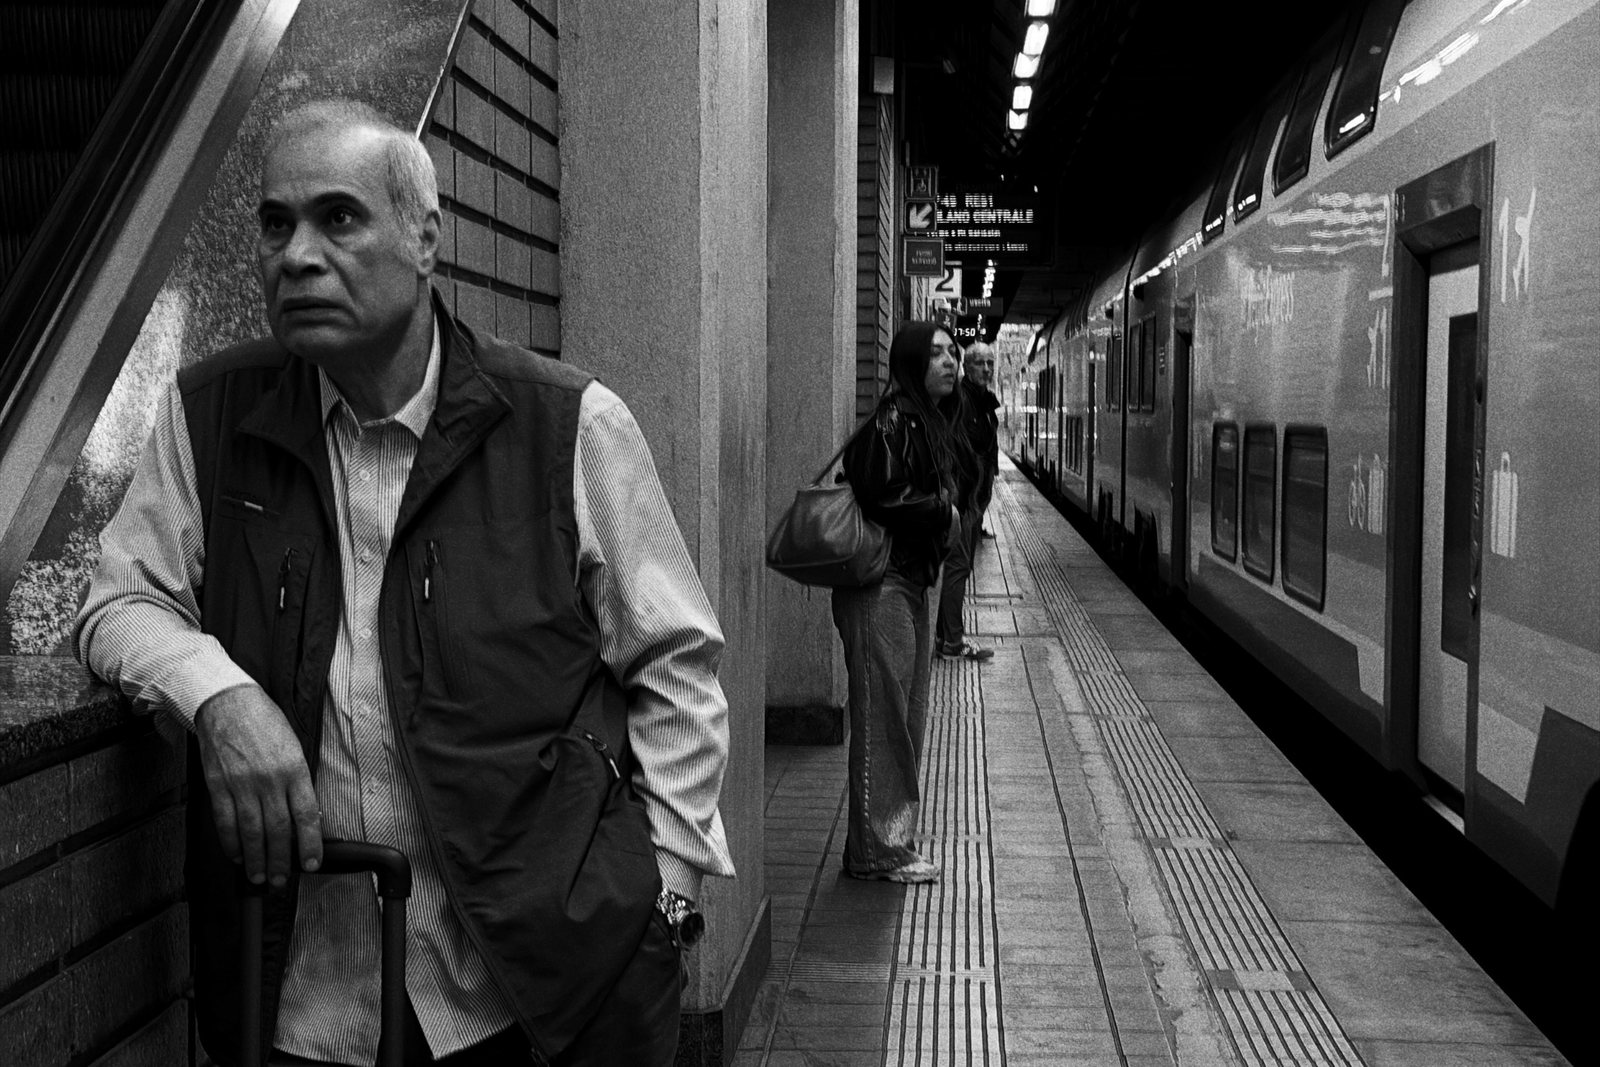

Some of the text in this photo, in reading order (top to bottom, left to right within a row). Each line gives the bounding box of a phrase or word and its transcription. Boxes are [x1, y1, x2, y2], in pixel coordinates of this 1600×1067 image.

[937, 209, 1034, 224] ILANO CENTRALE
[935, 267, 954, 292] 2
